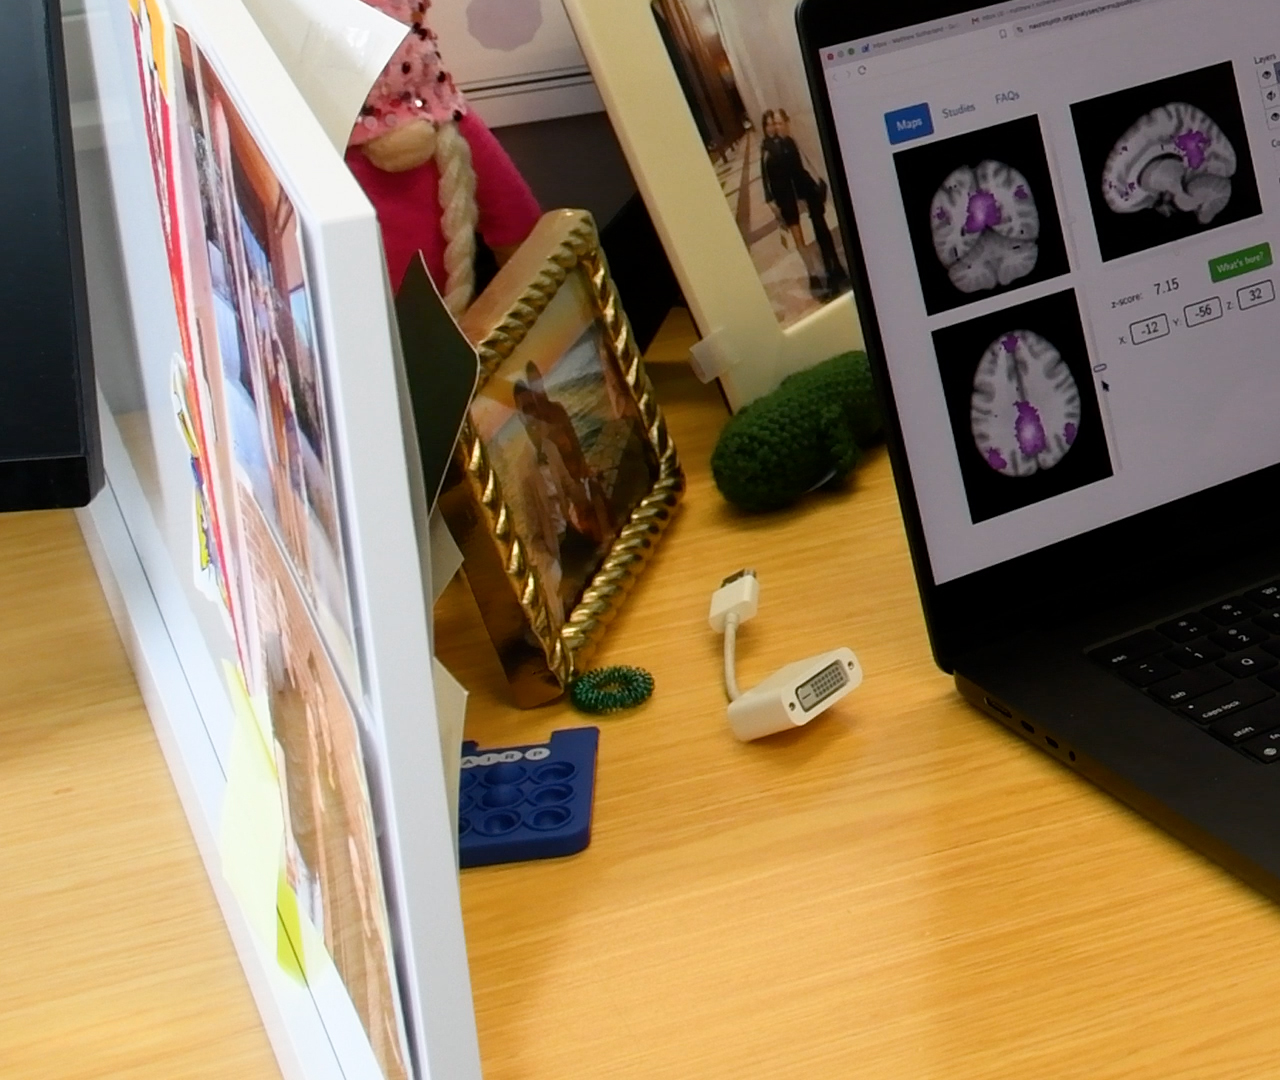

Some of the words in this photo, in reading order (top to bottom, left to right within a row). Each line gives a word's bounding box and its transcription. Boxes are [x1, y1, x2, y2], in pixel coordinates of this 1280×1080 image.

[1253, 53, 1277, 66] Layers
[896, 117, 923, 132] Maps
[942, 103, 976, 119] Studies
[995, 90, 1020, 105] FAQs
[1216, 259, 1244, 273] What's
[1111, 292, 1143, 308] z-score:
[1154, 277, 1180, 296] 7.15
[1141, 321, 1159, 336] -12
[1194, 304, 1212, 319] -56
[1248, 287, 1263, 302] 32
[1233, 727, 1254, 737] shift
